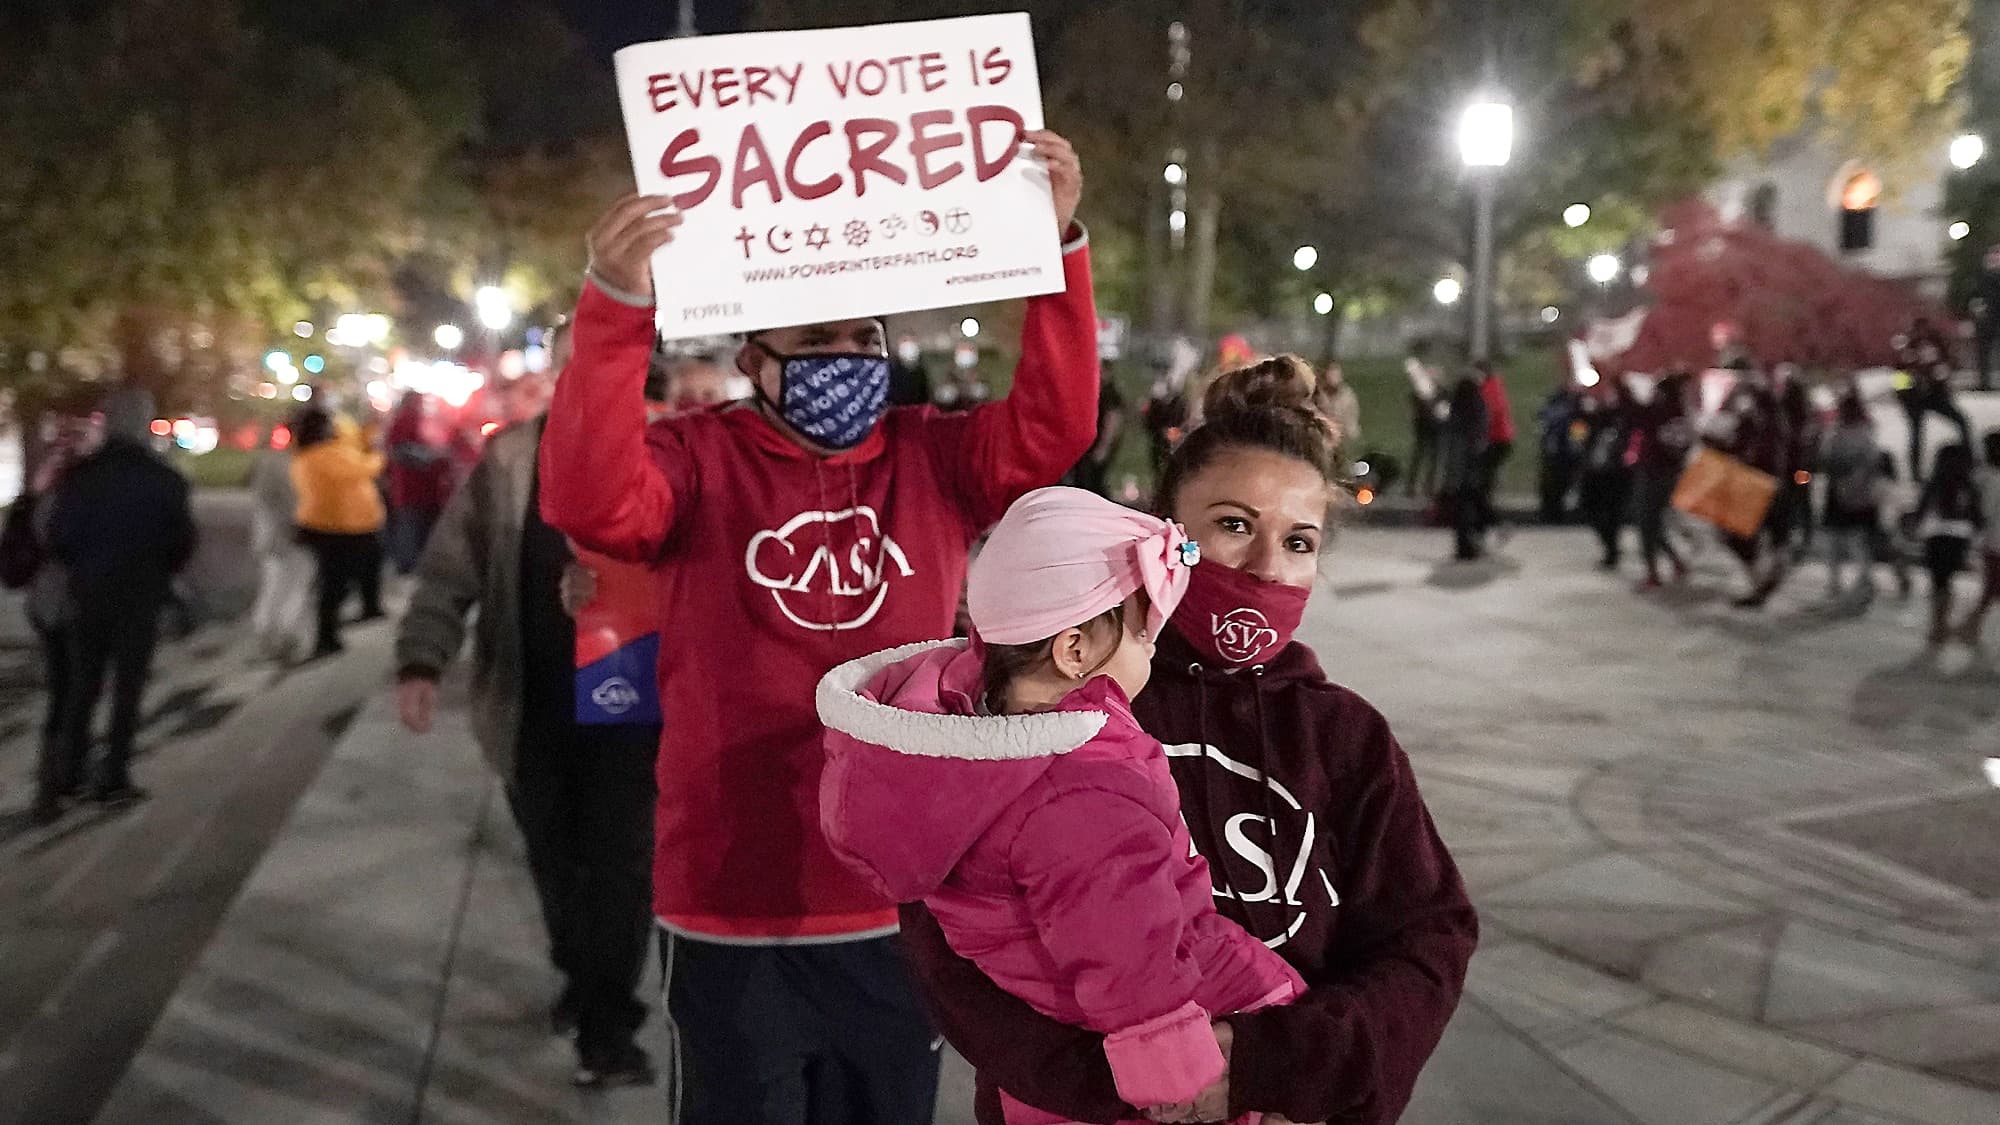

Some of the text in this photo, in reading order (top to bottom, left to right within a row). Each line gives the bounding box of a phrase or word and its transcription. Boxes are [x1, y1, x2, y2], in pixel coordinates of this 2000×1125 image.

[648, 47, 1012, 113] EVERY VOTE IS
[659, 105, 1025, 210] SACRED
[743, 244, 980, 284] WWW.POWERINTERFAITH.ORG
[682, 301, 744, 321] POWER
[746, 529, 915, 596] CASA
